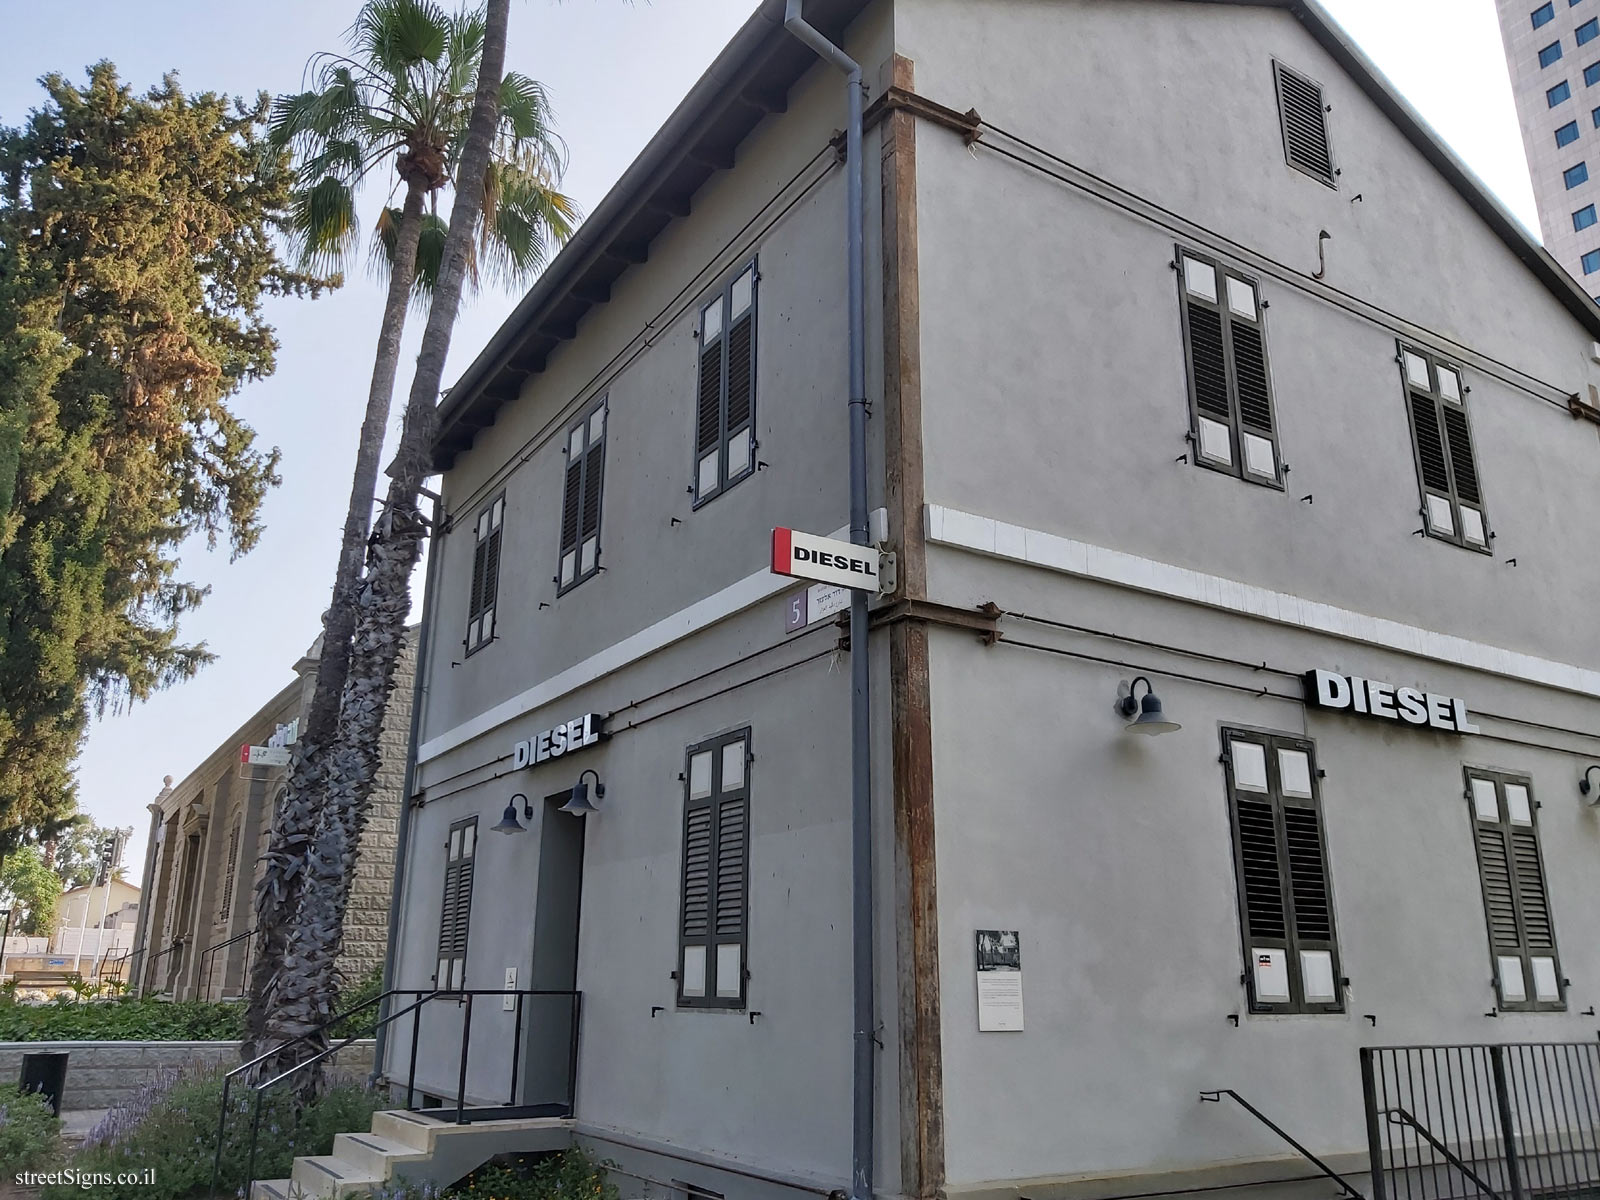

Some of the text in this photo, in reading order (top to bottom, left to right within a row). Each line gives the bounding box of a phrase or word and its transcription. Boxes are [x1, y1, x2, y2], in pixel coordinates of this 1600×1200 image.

[794, 546, 877, 577] DIESEL
[791, 598, 800, 624] 5
[1315, 668, 1481, 735] DIESEL
[513, 713, 599, 771] DIESEL
